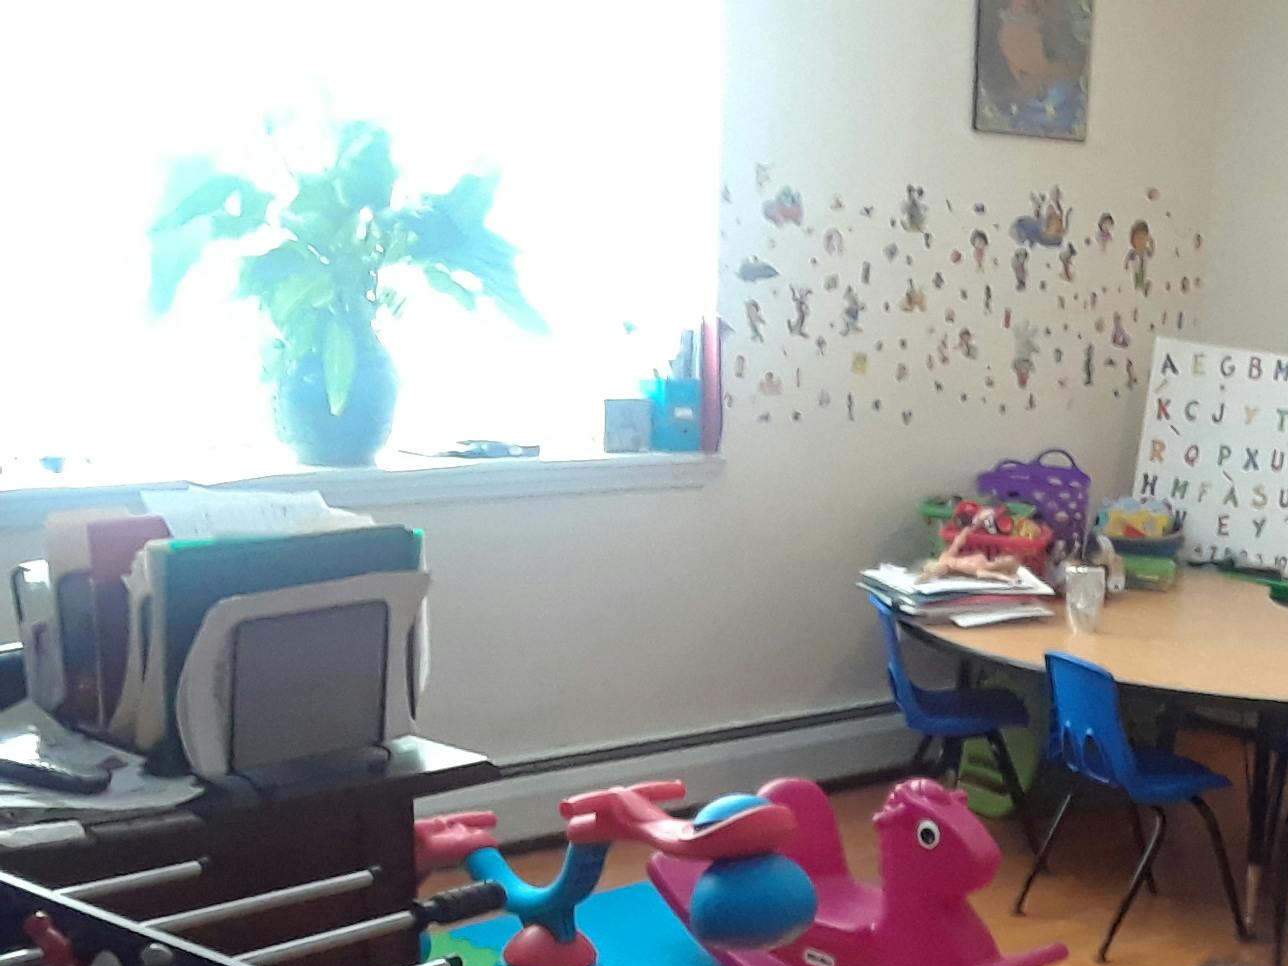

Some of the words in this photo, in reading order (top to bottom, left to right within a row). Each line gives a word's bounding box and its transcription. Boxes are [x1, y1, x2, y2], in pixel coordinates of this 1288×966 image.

[1161, 353, 1179, 376] A
[1191, 354, 1205, 376] E
[1220, 356, 1235, 377] G
[1248, 357, 1262, 379] B
[1156, 398, 1171, 421] K
[1184, 400, 1199, 421] C
[1211, 403, 1225, 424] J
[1244, 405, 1259, 425] Y
[1150, 440, 1166, 463] R
[1184, 445, 1200, 467] Q
[1217, 445, 1231, 466] P
[1243, 447, 1260, 471] X
[1271, 449, 1285, 472] U
[1171, 478, 1189, 500] M
[1223, 486, 1239, 508] A
[1252, 485, 1269, 509] S
[1217, 515, 1230, 537] E
[1252, 518, 1266, 537] Y
